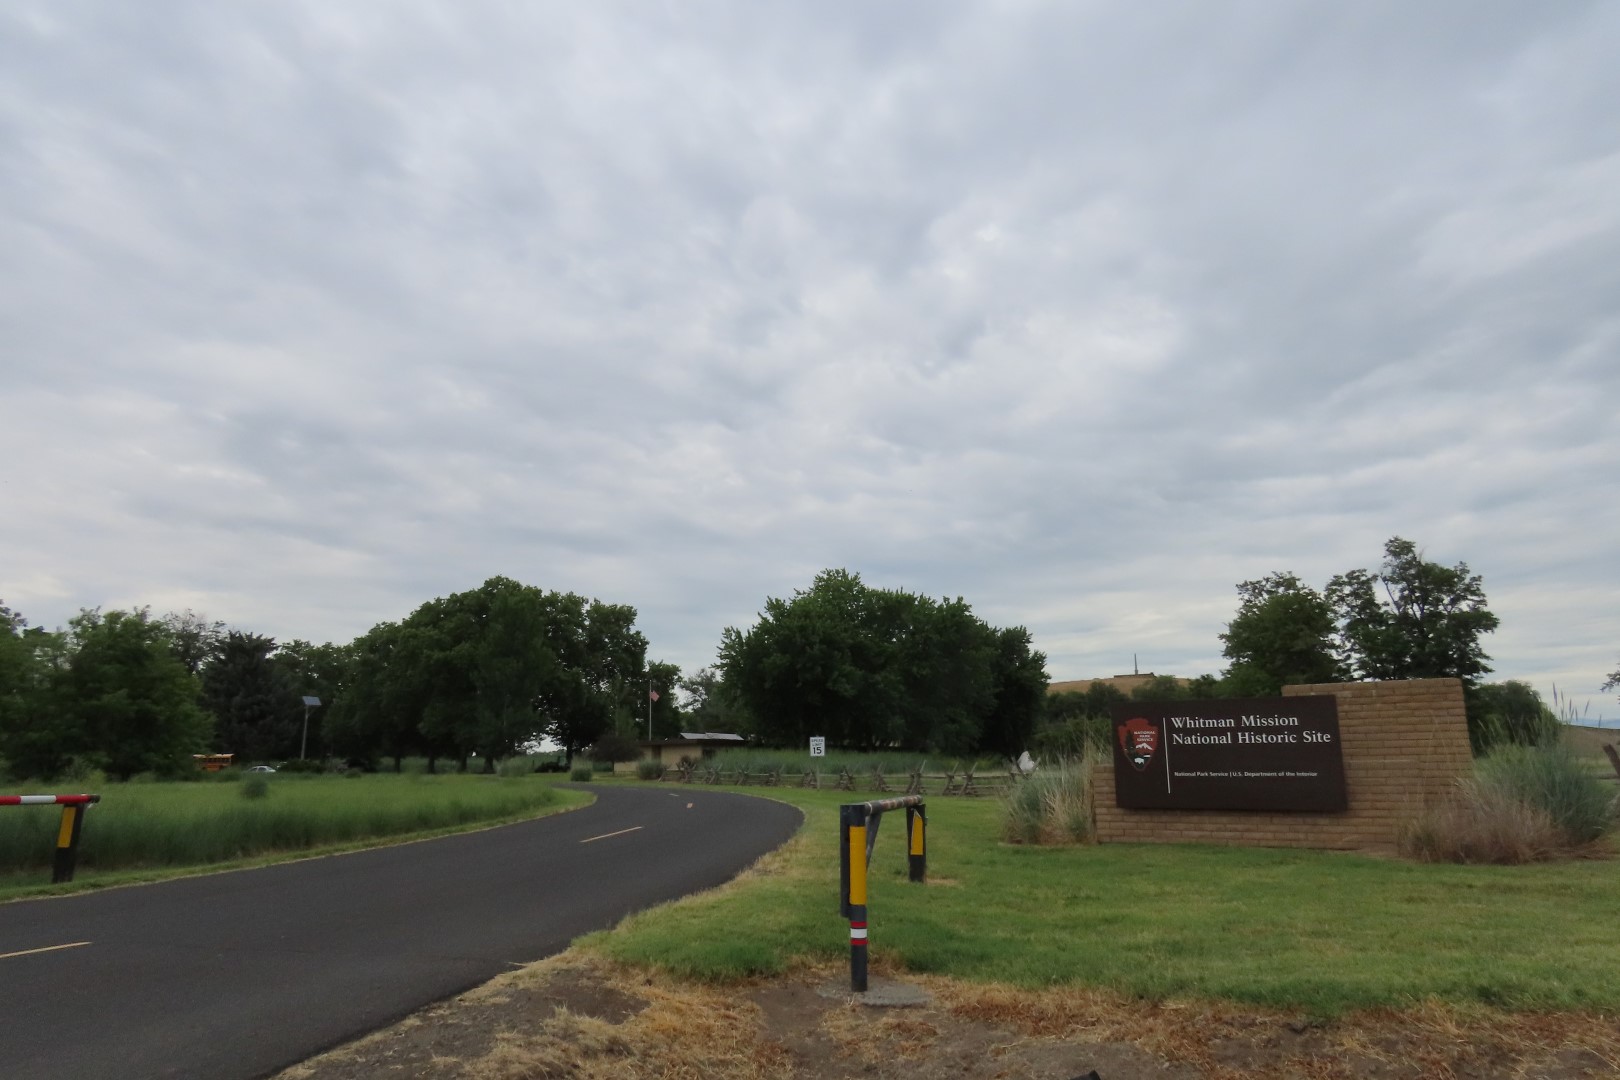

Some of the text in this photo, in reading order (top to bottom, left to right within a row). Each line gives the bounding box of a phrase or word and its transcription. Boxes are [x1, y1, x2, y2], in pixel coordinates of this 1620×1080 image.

[1171, 714, 1299, 729] Whitman Mission
[1172, 730, 1331, 745] National Historic Site
[813, 746, 822, 754] 15
